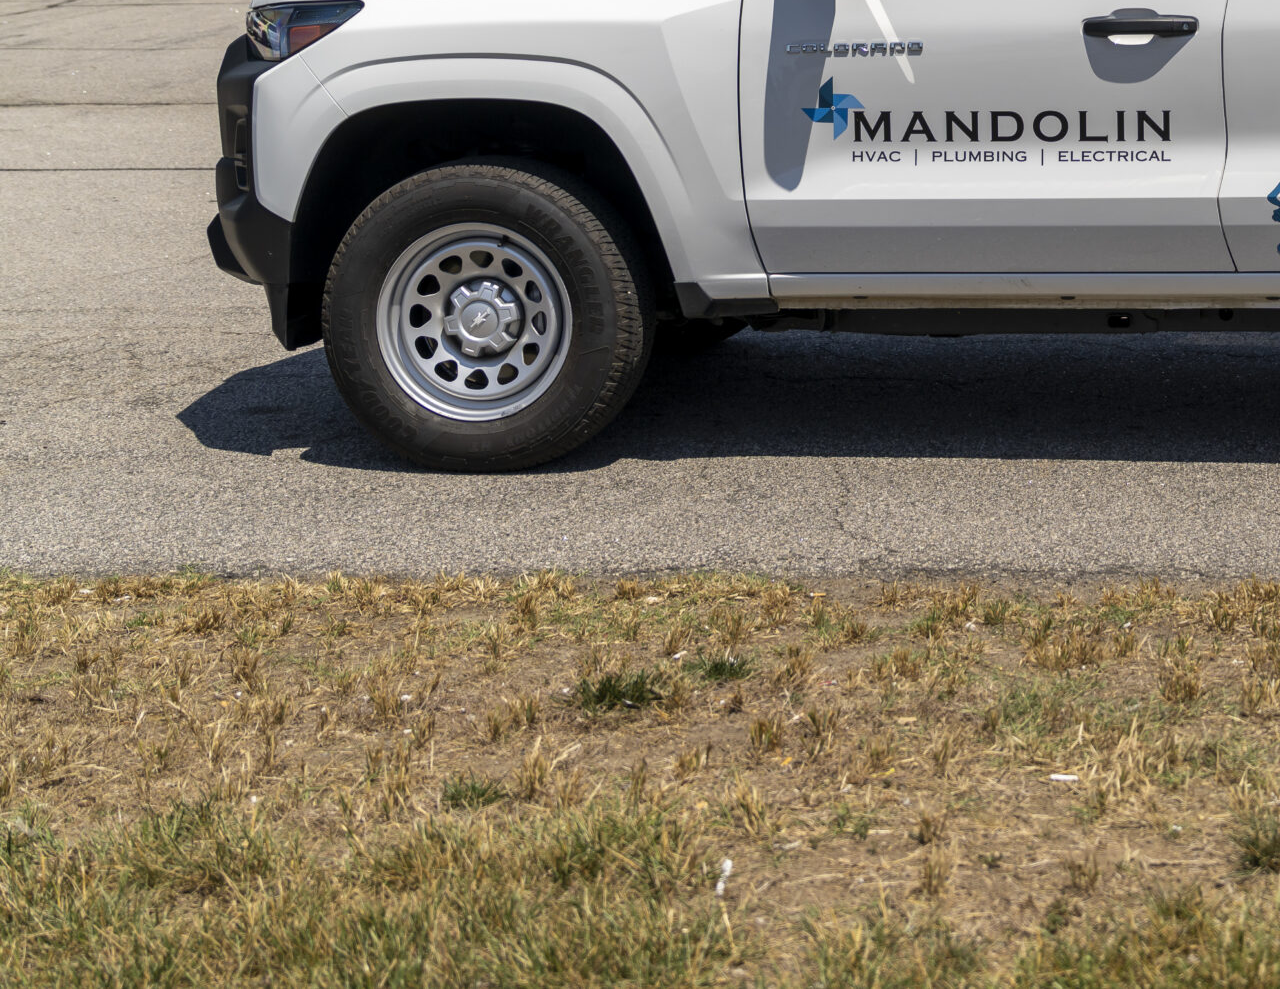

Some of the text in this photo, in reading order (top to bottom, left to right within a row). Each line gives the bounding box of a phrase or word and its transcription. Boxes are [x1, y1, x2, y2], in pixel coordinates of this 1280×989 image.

[786, 41, 924, 57] COLORADO
[853, 110, 1172, 143] MANDOLIN
[852, 150, 1171, 162] HVAC PLUMBING ELECTRICAL
